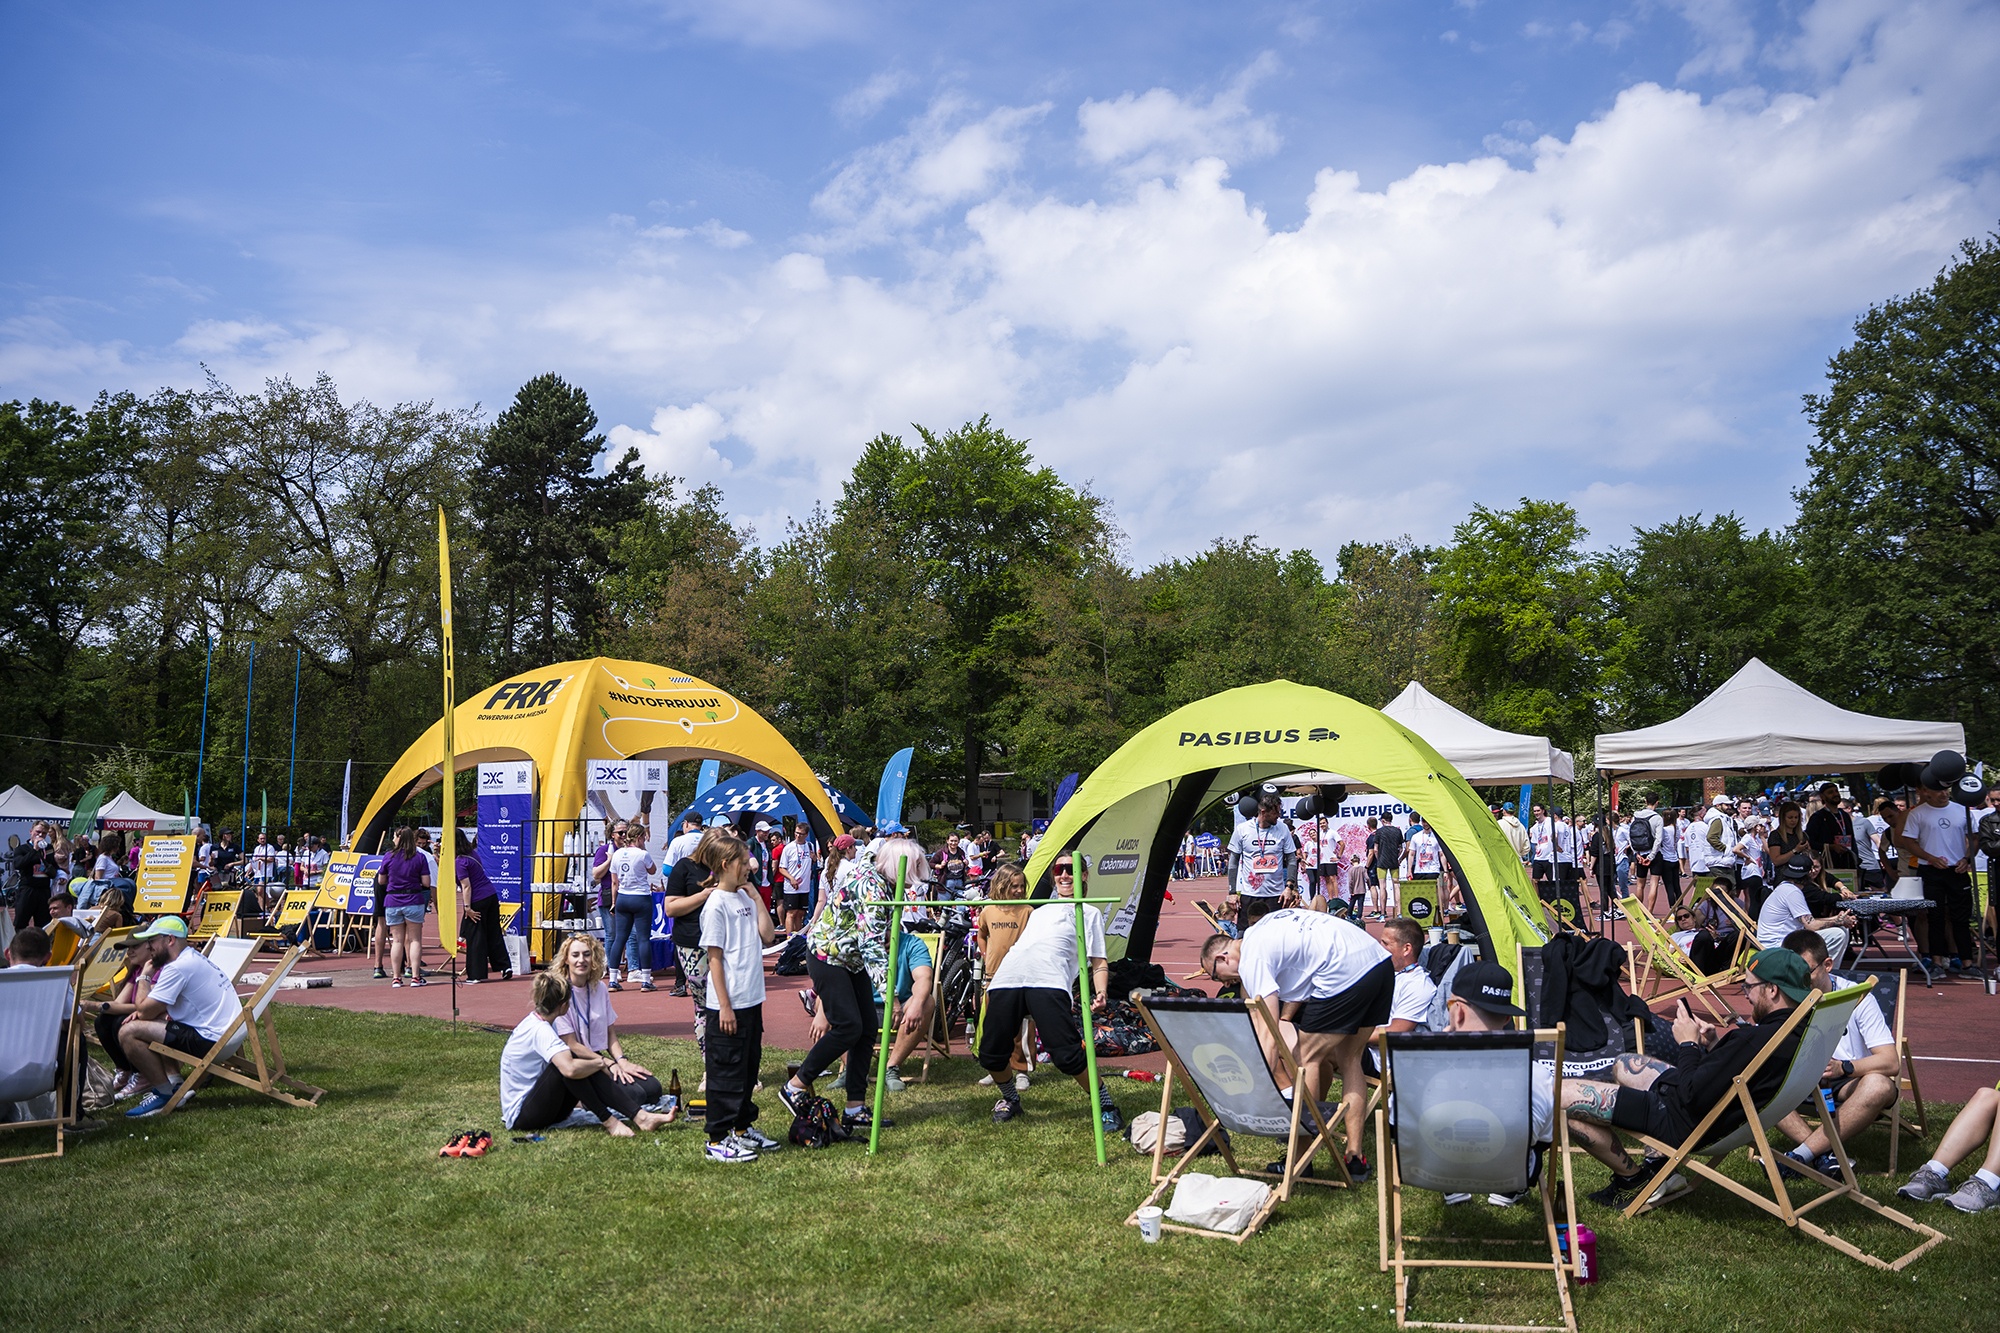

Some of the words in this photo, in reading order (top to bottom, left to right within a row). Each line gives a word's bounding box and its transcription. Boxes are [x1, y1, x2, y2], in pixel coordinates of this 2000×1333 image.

[483, 679, 562, 710] FRR
[608, 690, 721, 708] #NOTOFRRUUU!
[526, 708, 548, 718] MIEJSKA
[1178, 729, 1300, 747] PASIBUS
[482, 772, 504, 785] DXC
[596, 767, 627, 780] DXC
[106, 821, 149, 830] VORWERK
[337, 876, 352, 884] fina
[208, 901, 232, 912] FRR
[286, 901, 307, 911] FRR
[991, 921, 1019, 929] MINIKID
[1541, 1059, 1614, 1071] PRYCUPNIJ
